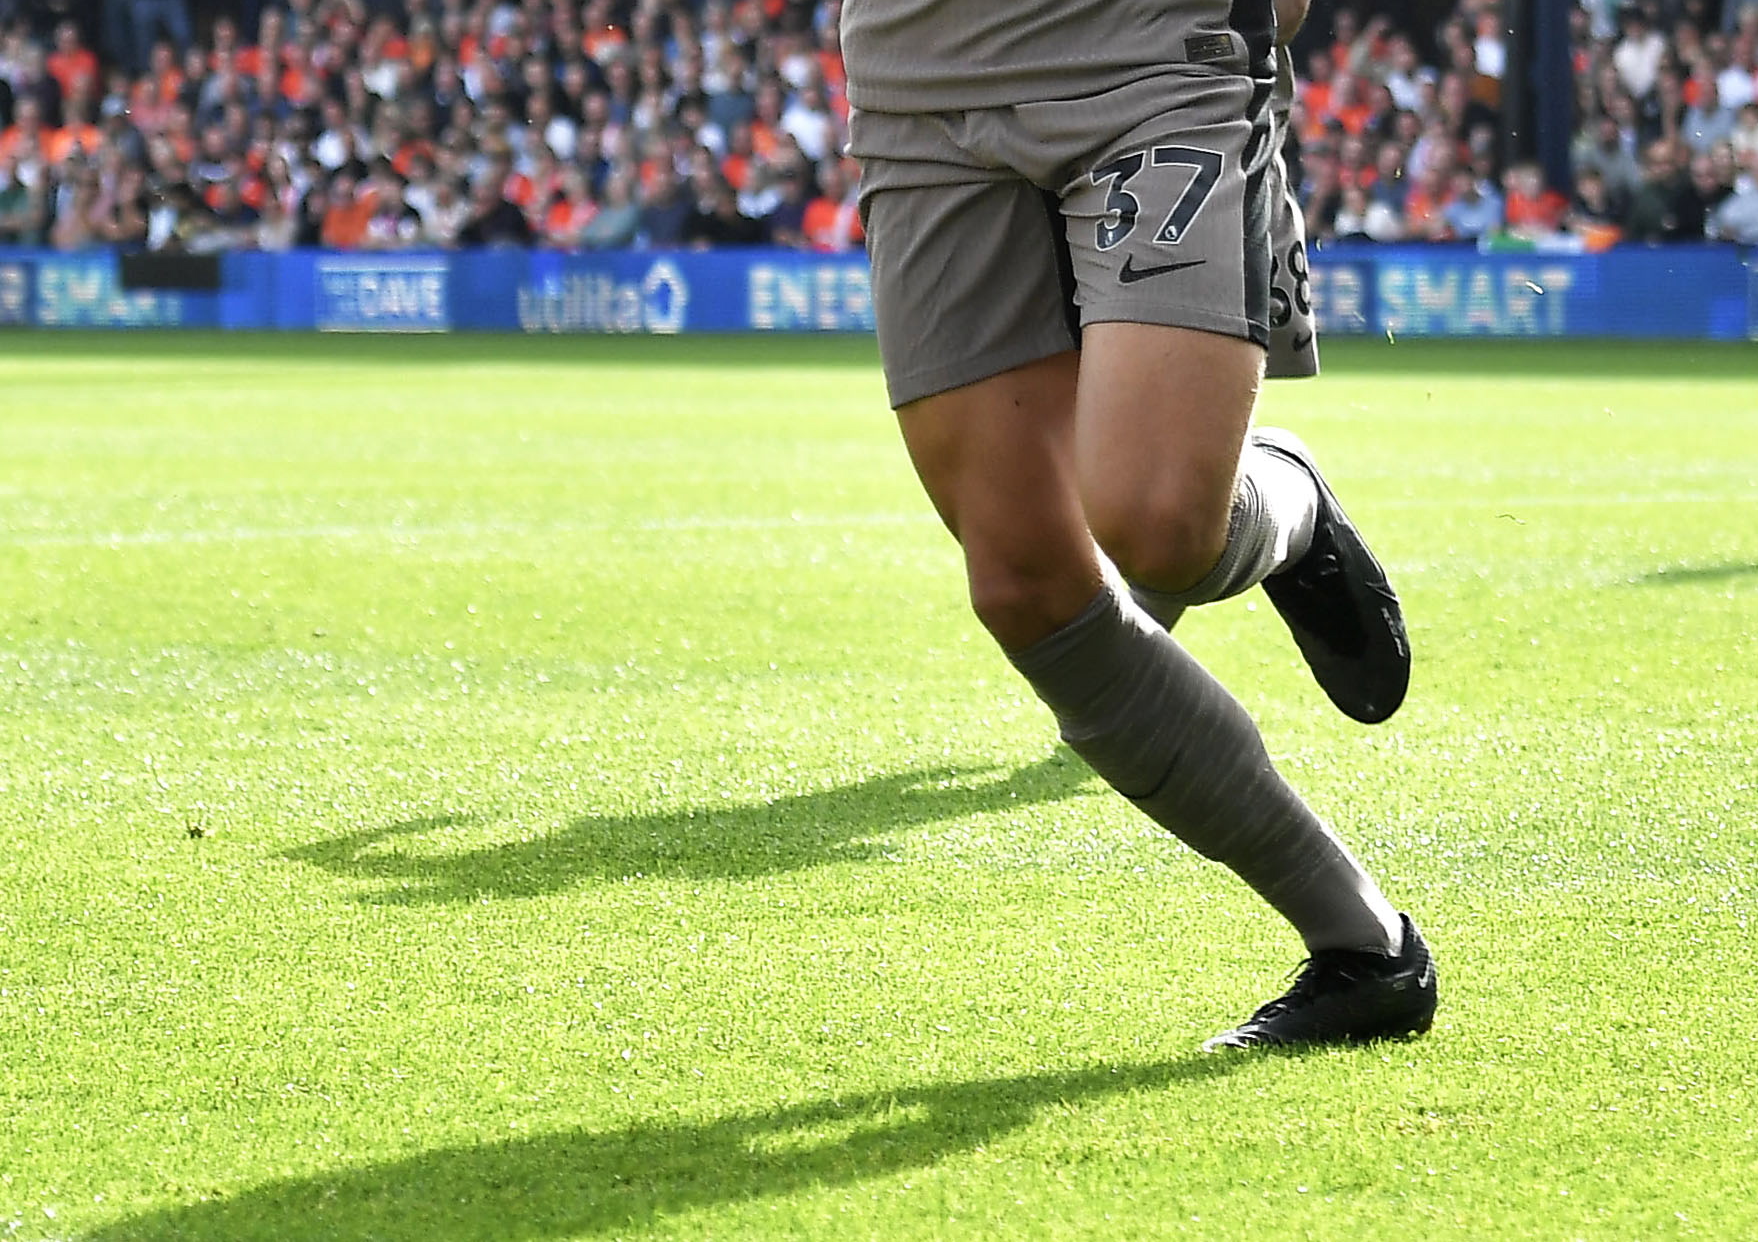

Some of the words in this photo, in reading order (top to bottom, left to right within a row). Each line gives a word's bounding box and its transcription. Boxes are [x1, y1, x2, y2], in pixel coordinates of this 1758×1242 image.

[1089, 144, 1225, 251] 37
[748, 264, 874, 331] ENER
[1377, 266, 1572, 335] SMART
